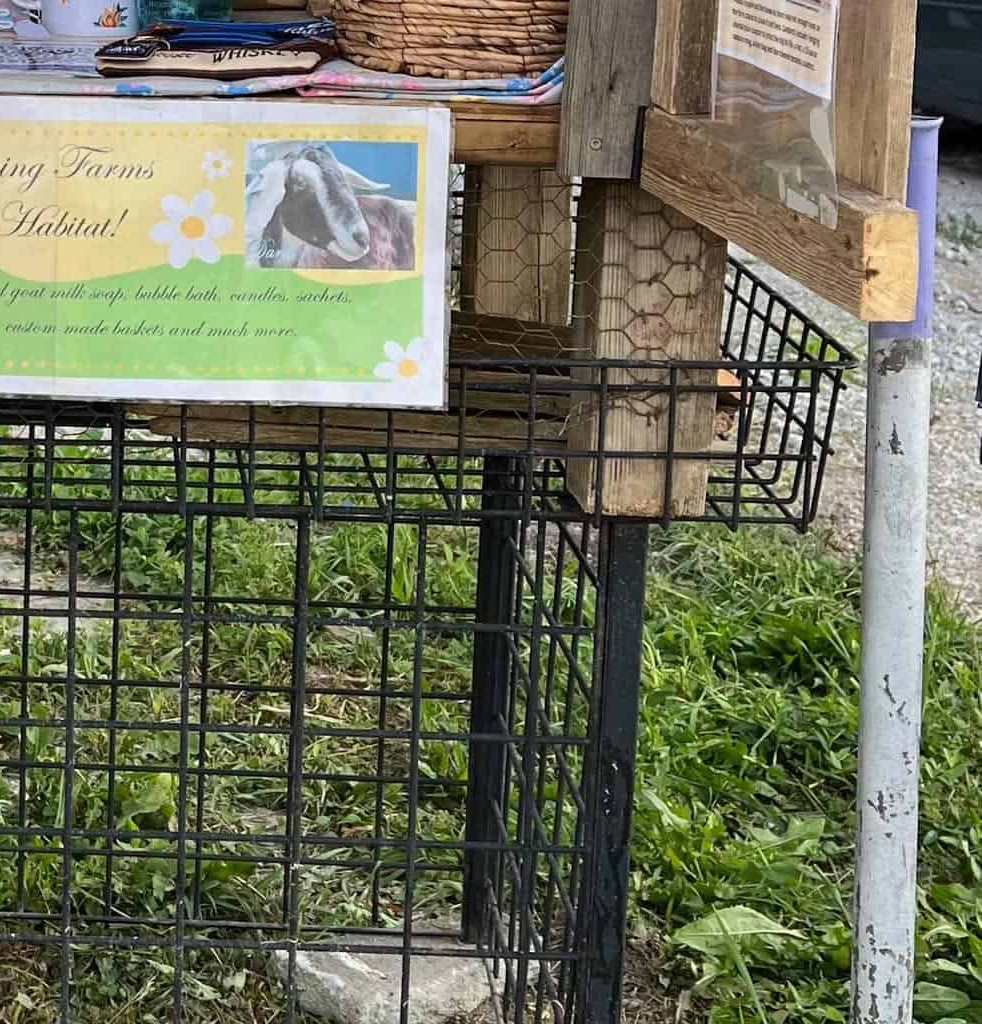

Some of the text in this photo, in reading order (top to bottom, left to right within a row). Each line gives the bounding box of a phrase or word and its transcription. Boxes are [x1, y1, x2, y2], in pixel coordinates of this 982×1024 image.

[54, 143, 155, 180] Farms
[9, 282, 47, 306] goat
[50, 283, 85, 300] milk
[134, 285, 182, 302] bubble
[5, 318, 57, 334] custom
[63, 319, 109, 336] made
[112, 319, 166, 337] baskets
[169, 321, 205, 337] and
[207, 321, 249, 337] much
[253, 325, 298, 338] more.
